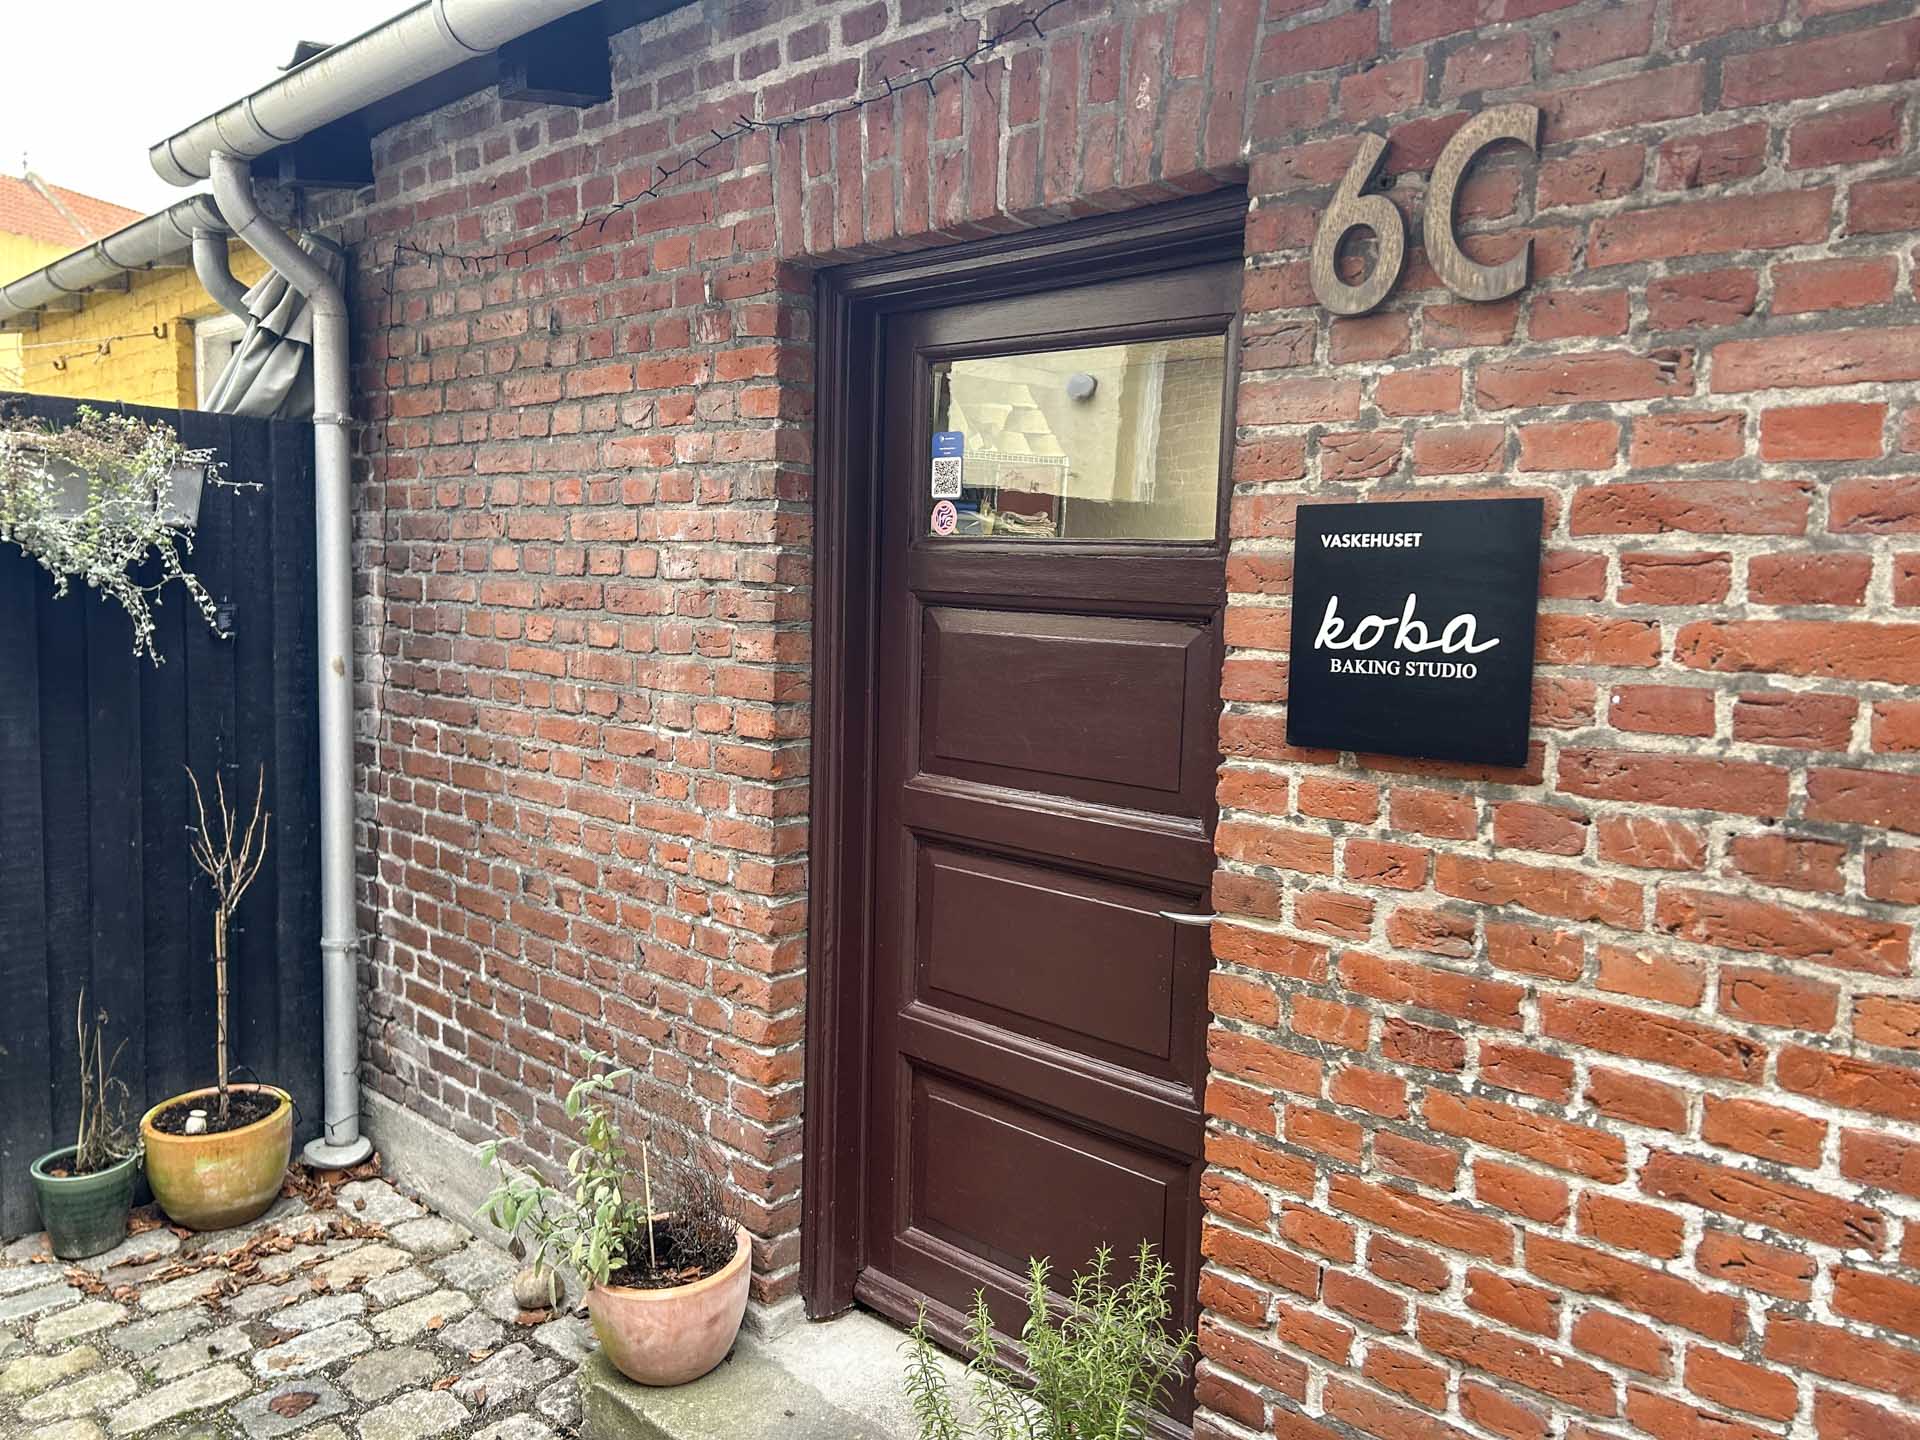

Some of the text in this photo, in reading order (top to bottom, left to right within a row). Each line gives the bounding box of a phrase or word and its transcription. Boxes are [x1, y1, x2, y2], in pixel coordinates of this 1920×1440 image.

[1310, 103, 1541, 315] 6C
[1321, 533, 1422, 548] VASKEHUSET
[1314, 593, 1500, 654] koba
[1330, 658, 1478, 679] BAKING STUDIO
